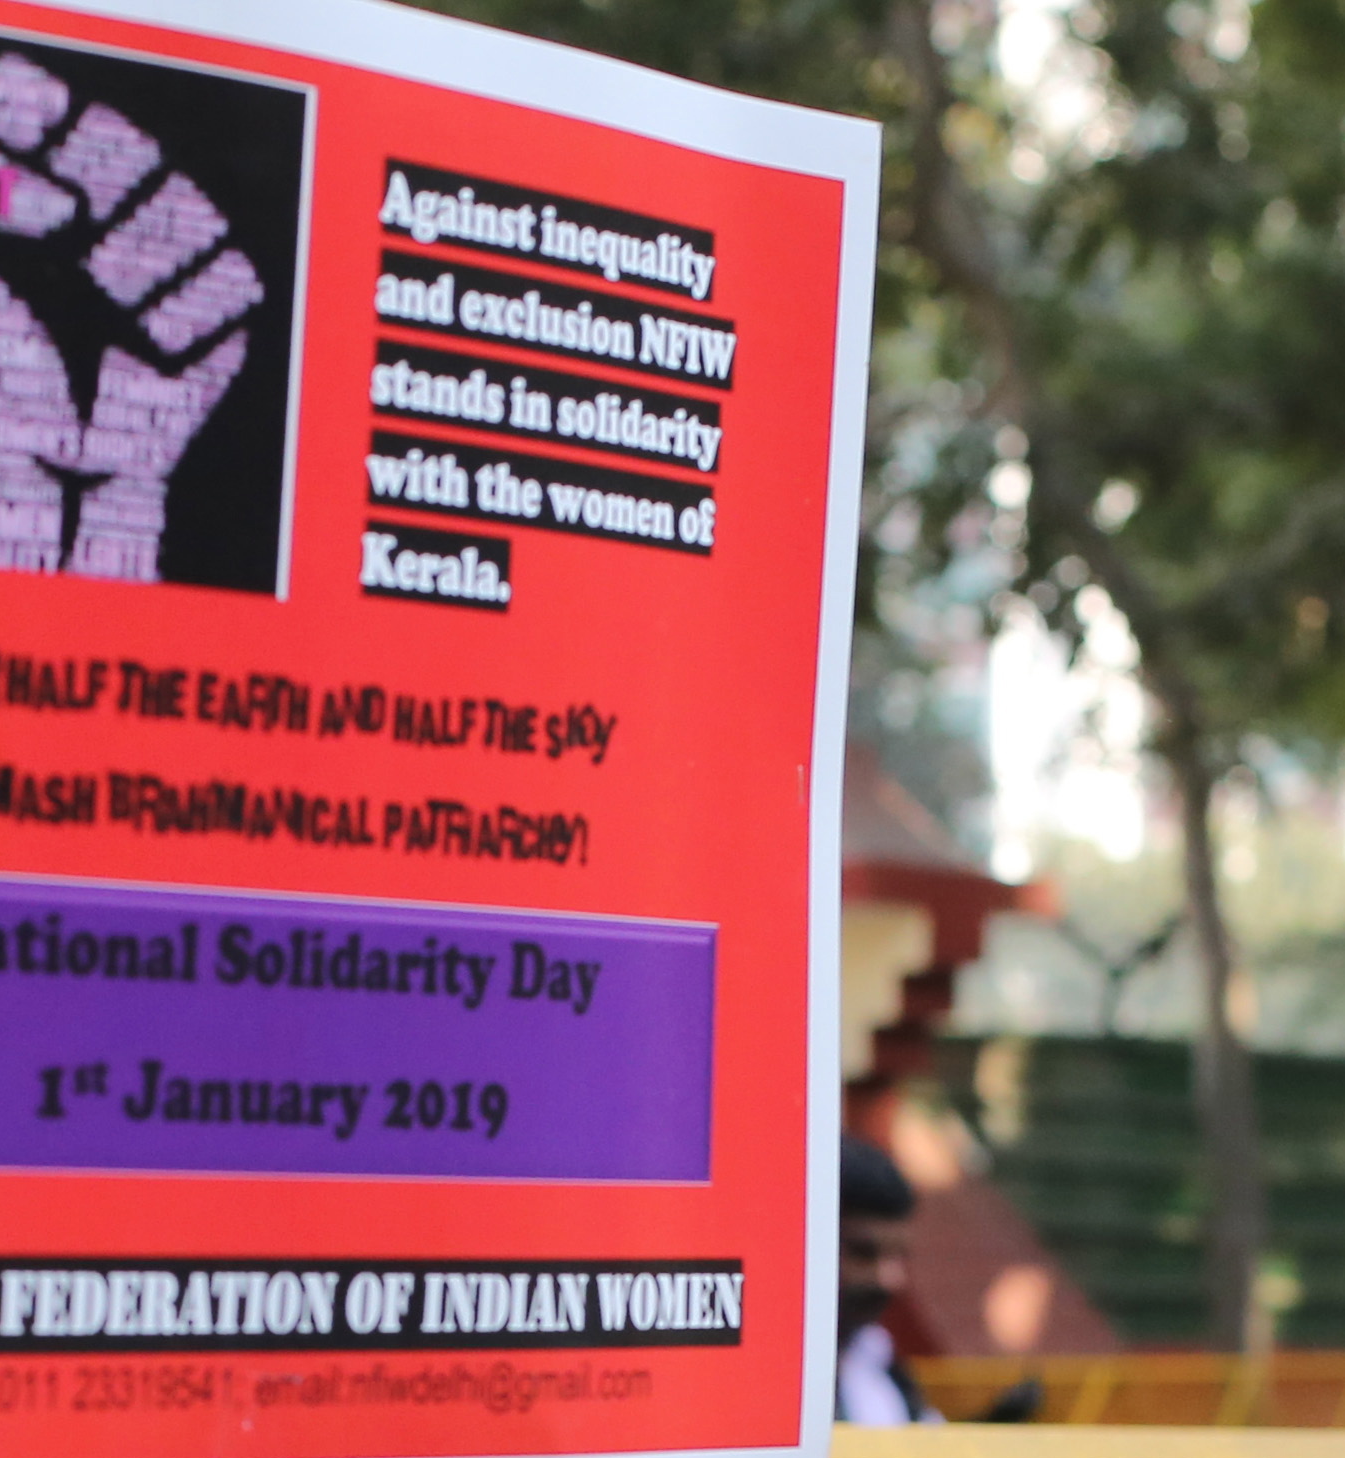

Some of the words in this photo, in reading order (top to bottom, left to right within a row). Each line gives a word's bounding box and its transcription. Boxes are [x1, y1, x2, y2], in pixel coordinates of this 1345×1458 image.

[378, 168, 537, 253] Against
[539, 204, 716, 301] inequality
[374, 272, 455, 326] and
[458, 289, 634, 361] exclusion
[638, 312, 737, 380] NFIW
[369, 359, 506, 424] stands
[509, 375, 552, 432] in
[556, 392, 723, 473] solidarity
[364, 447, 469, 508] with
[474, 461, 542, 518] the
[547, 481, 675, 541] women
[679, 497, 717, 547] of
[360, 530, 512, 604] Kerala.
[8, 655, 108, 713] HALF
[118, 659, 187, 720] THE
[196, 669, 310, 734] EARTH
[318, 684, 386, 738] AND
[393, 693, 477, 746] HALF
[484, 697, 537, 754] THE
[214, 921, 495, 1011] Solidarity
[508, 939, 602, 1016] Day
[34, 1059, 110, 1119] 1st
[122, 1057, 370, 1142] January
[382, 1077, 510, 1140] 2019
[344, 1270, 416, 1335] OF
[419, 1271, 591, 1335] INDIAN
[596, 1271, 745, 1332] WOMEN
